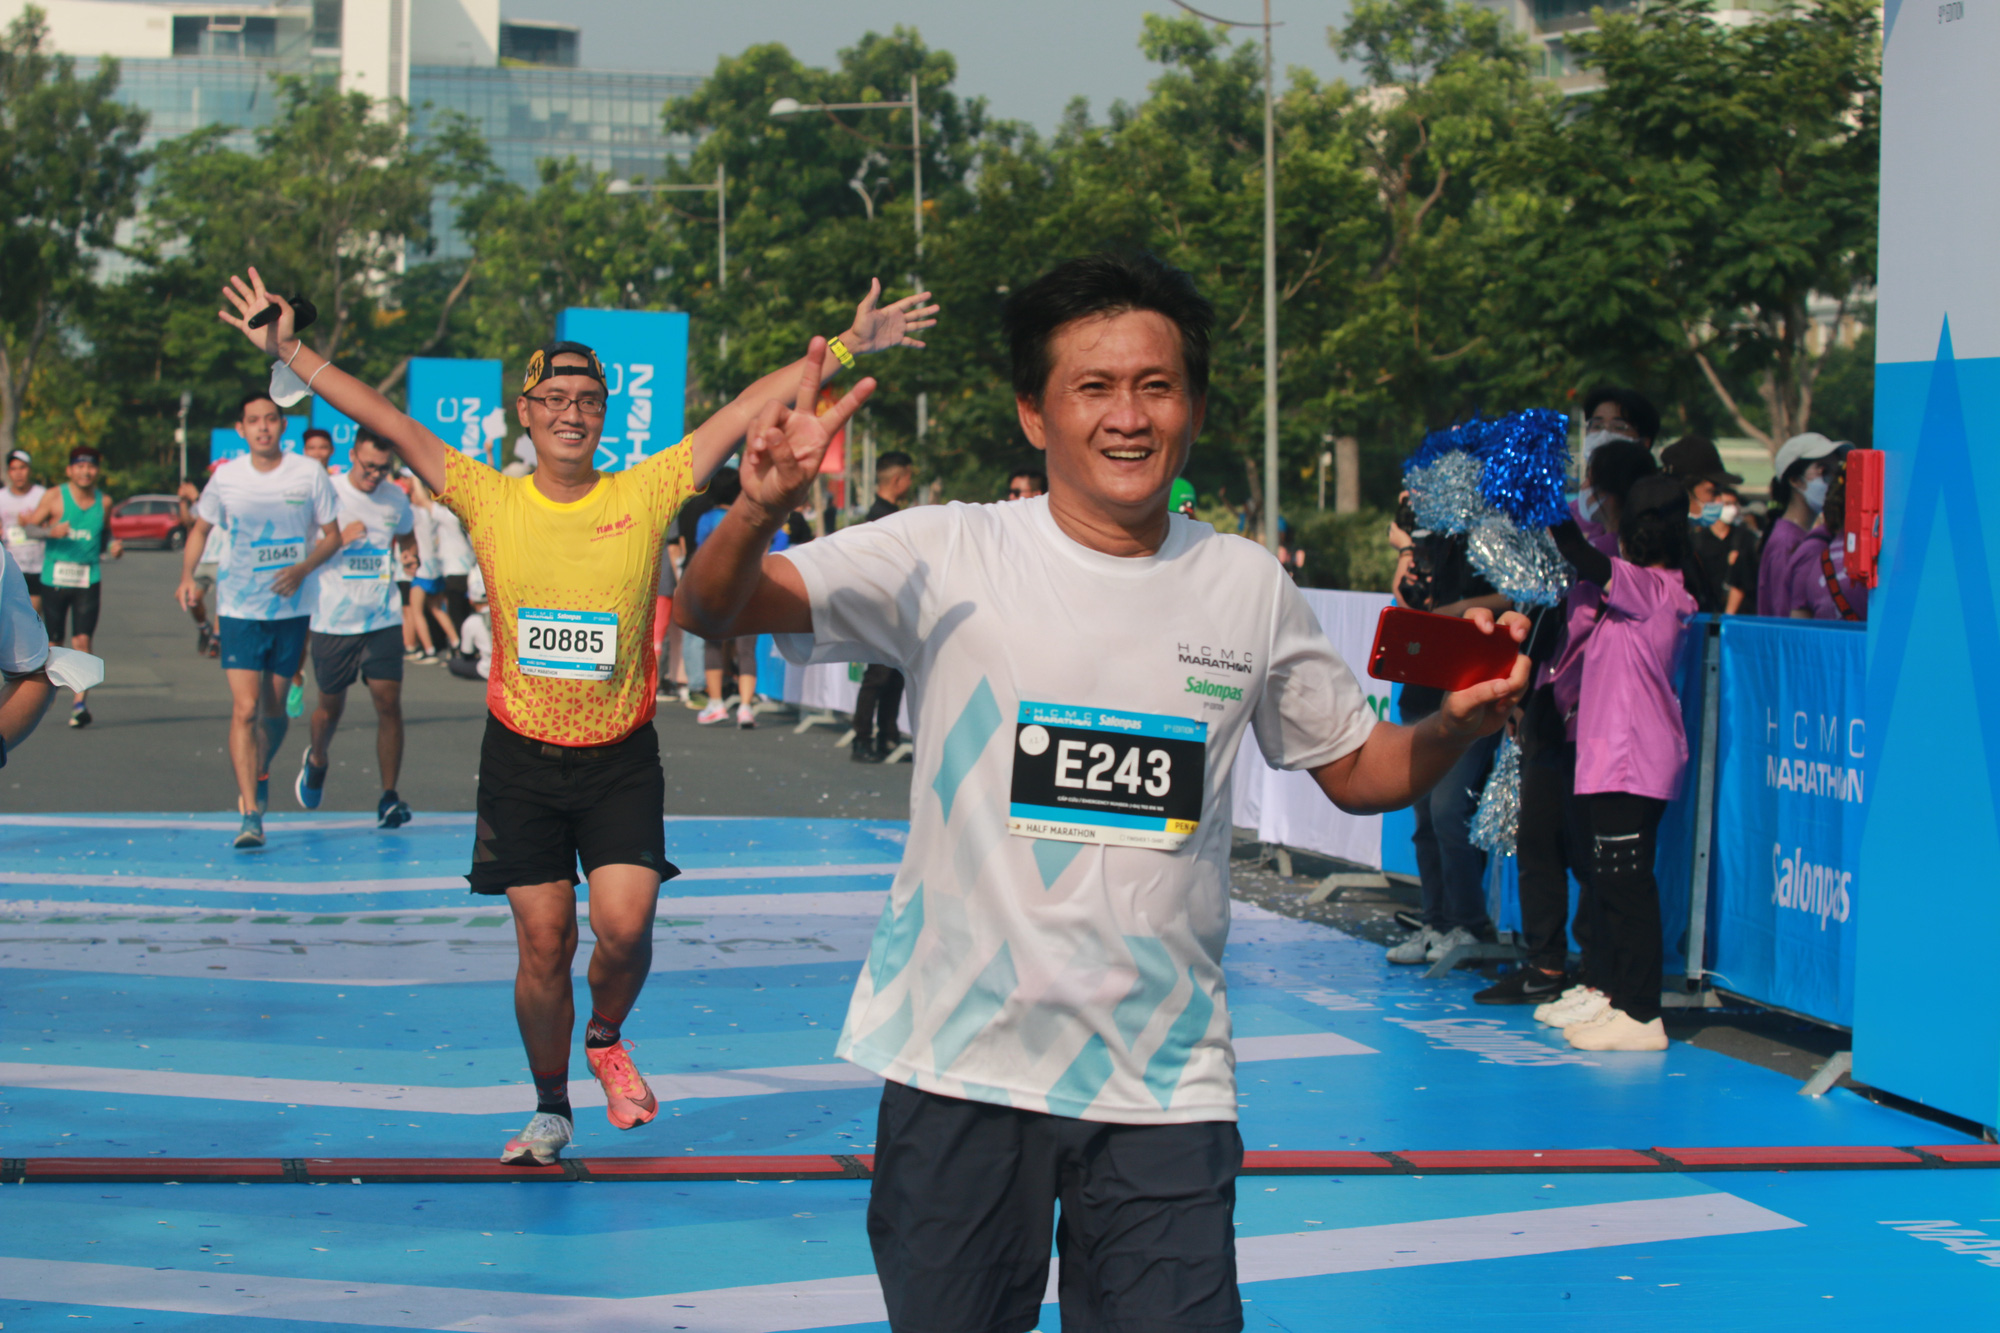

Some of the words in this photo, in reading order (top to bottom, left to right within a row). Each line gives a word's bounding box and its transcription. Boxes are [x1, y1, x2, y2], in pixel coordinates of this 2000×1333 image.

[258, 546, 298, 563] 21645
[529, 626, 604, 654] 20885
[1178, 654, 1252, 674] MARATHON
[1184, 676, 1244, 702] Salonpas
[1033, 714, 1093, 727] MARATHON
[1098, 713, 1143, 730] Salonpas
[1767, 706, 1866, 759] HCMC
[1054, 738, 1172, 798] E243
[1026, 822, 1048, 834] HALF
[1049, 824, 1096, 839] MARATHON
[1175, 821, 1189, 831] PEN
[1771, 842, 1852, 931] Salonpas
